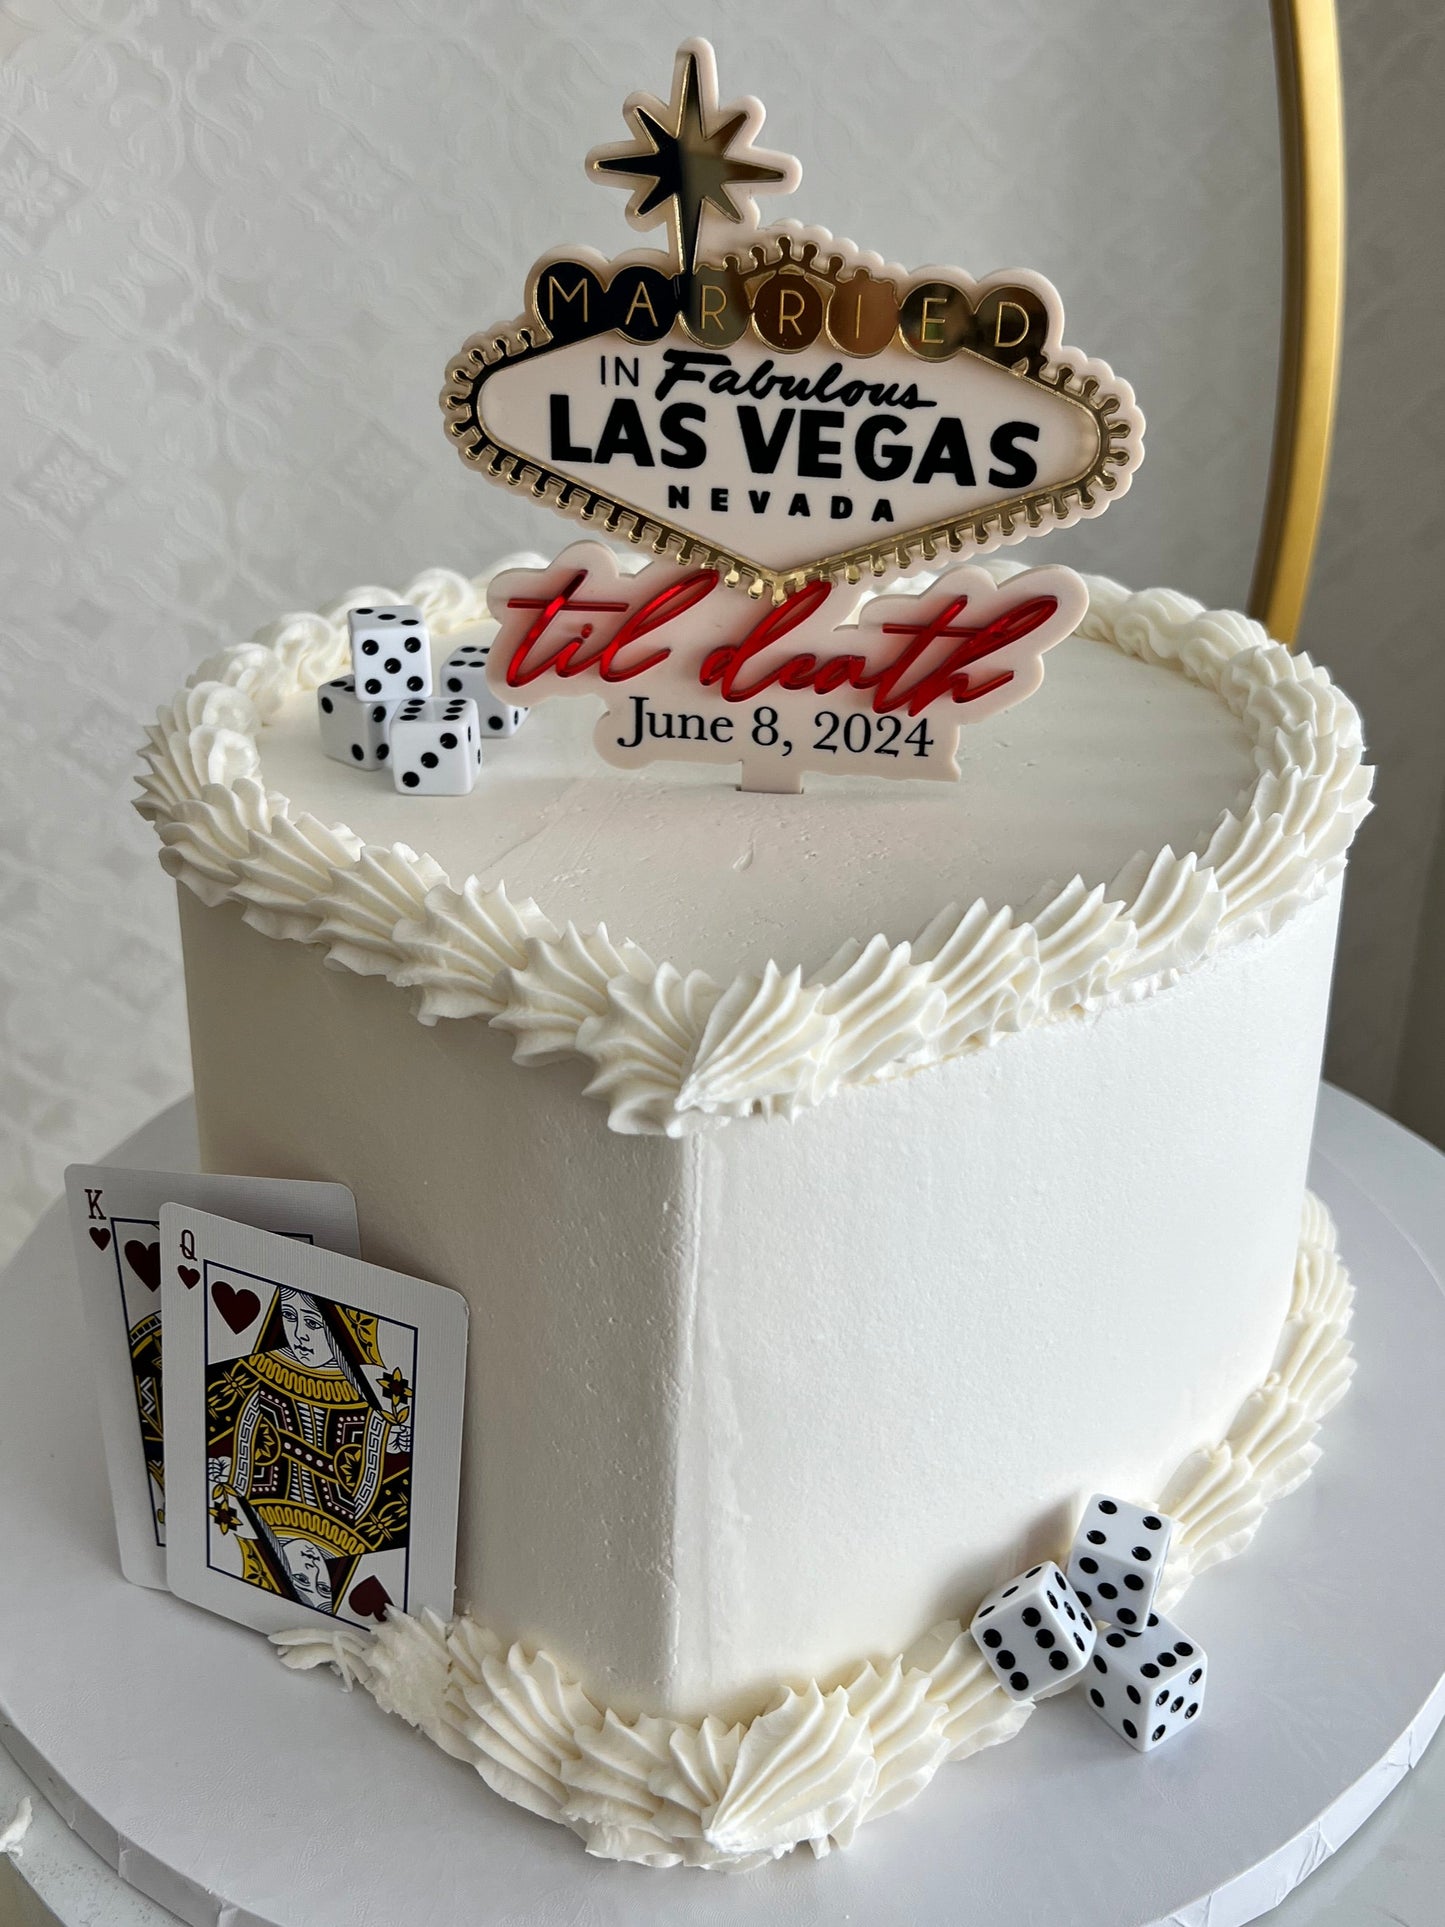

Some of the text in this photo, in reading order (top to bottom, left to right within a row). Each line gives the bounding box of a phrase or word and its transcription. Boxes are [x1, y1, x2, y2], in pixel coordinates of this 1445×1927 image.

[548, 277, 1031, 348] MARRIED
[600, 349, 938, 408] IN Fabulous
[549, 394, 1041, 489] LAS VEGAS
[667, 484, 895, 523] NEVADA
[506, 568, 1059, 718] til death
[616, 695, 935, 758] June 8, 2024
[84, 1188, 107, 1220] K
[179, 1229, 198, 1262] Q
